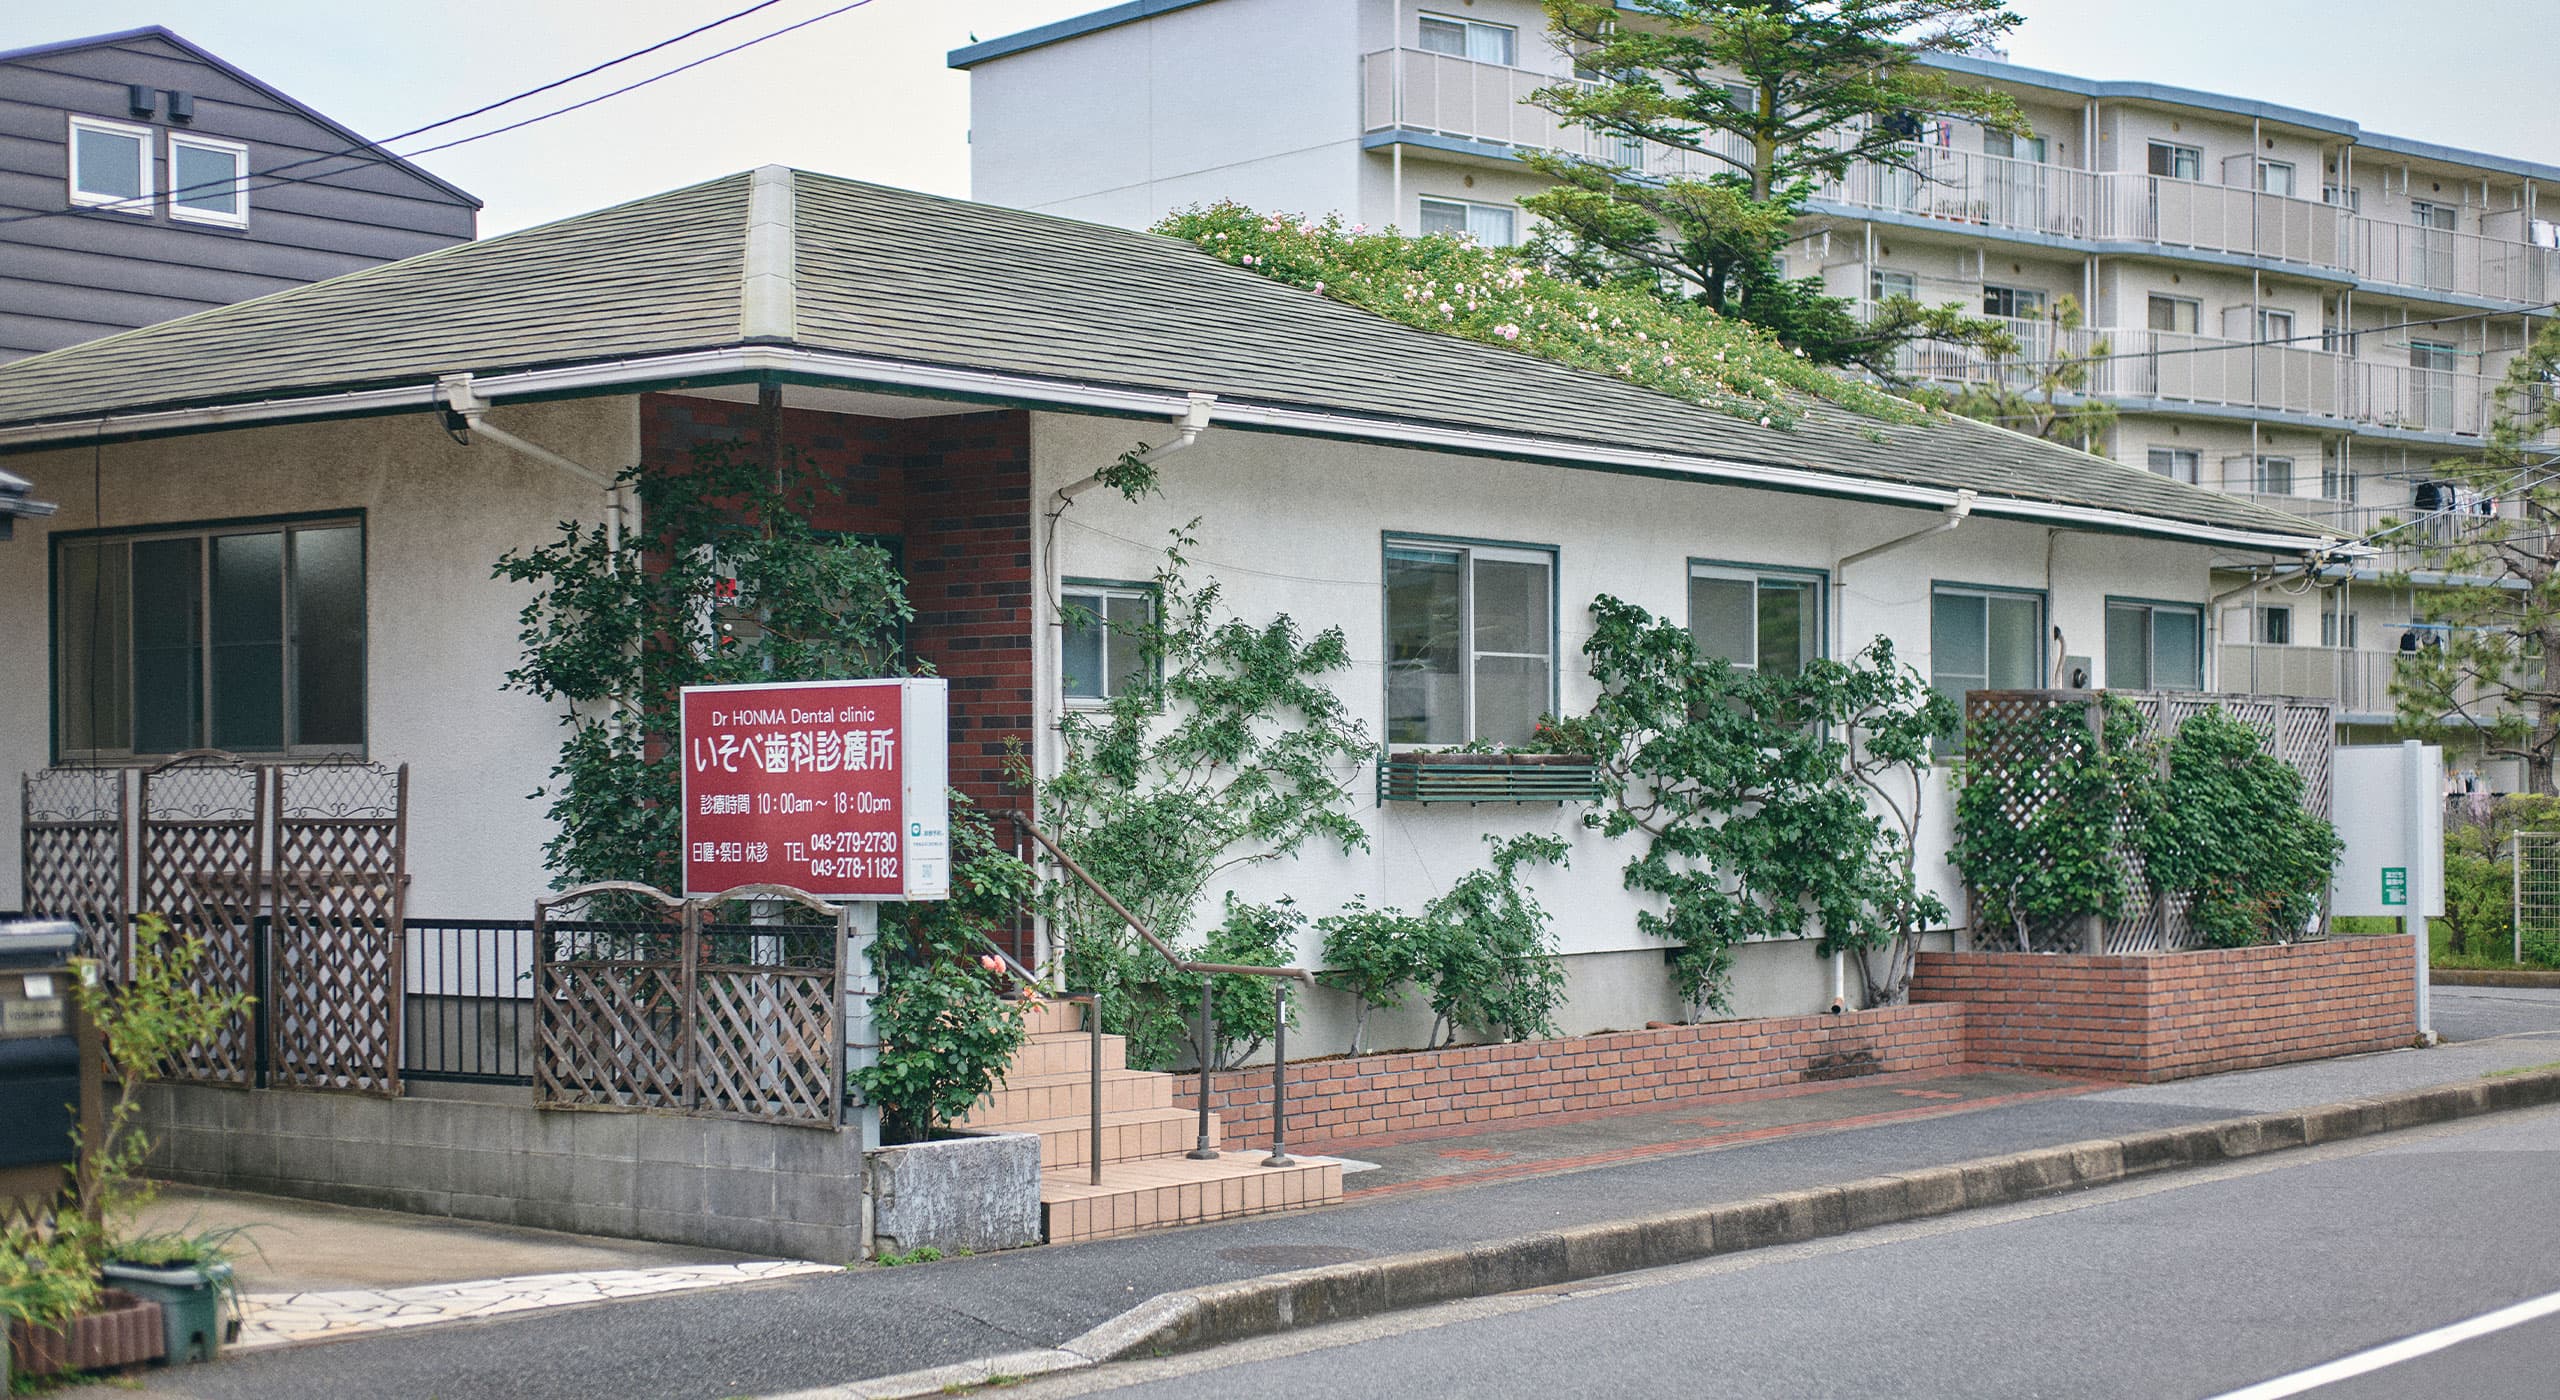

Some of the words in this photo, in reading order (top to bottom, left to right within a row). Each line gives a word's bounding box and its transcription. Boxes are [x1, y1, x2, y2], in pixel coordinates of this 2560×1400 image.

[713, 711, 728, 727] Dr
[733, 708, 786, 726] HONMA
[791, 707, 834, 725] Dental
[840, 706, 875, 722] clinic
[694, 727, 895, 773] いそべ歯科診療所
[700, 793, 750, 815] 診療時間
[745, 842, 768, 863] 休診
[784, 842, 809, 862] TEL
[811, 831, 897, 853] 043-279-2730
[811, 857, 898, 878] 043-278-1182
